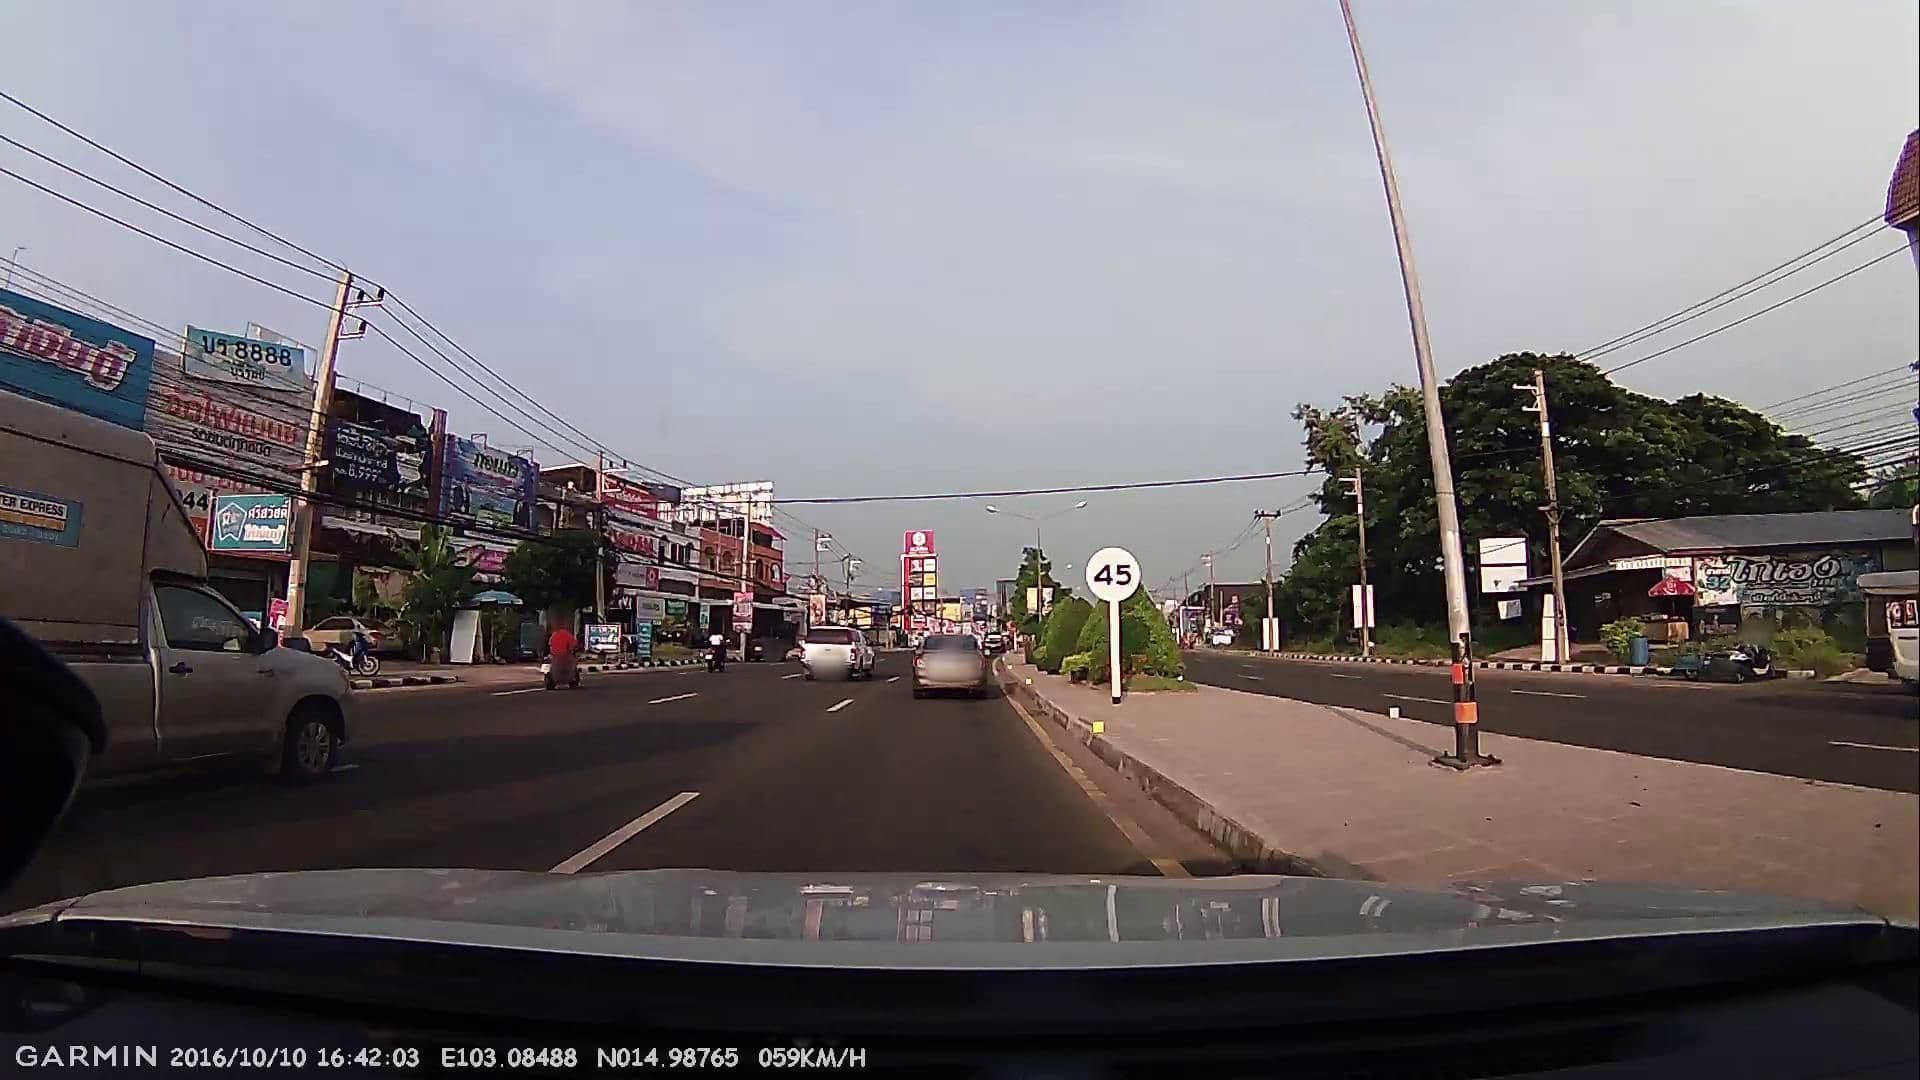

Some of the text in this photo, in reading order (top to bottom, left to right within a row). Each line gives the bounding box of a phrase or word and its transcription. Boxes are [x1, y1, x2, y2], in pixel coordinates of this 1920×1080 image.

[235, 340, 292, 367] 8888
[20, 498, 64, 517] EXPRESS
[1094, 564, 1132, 586] 45
